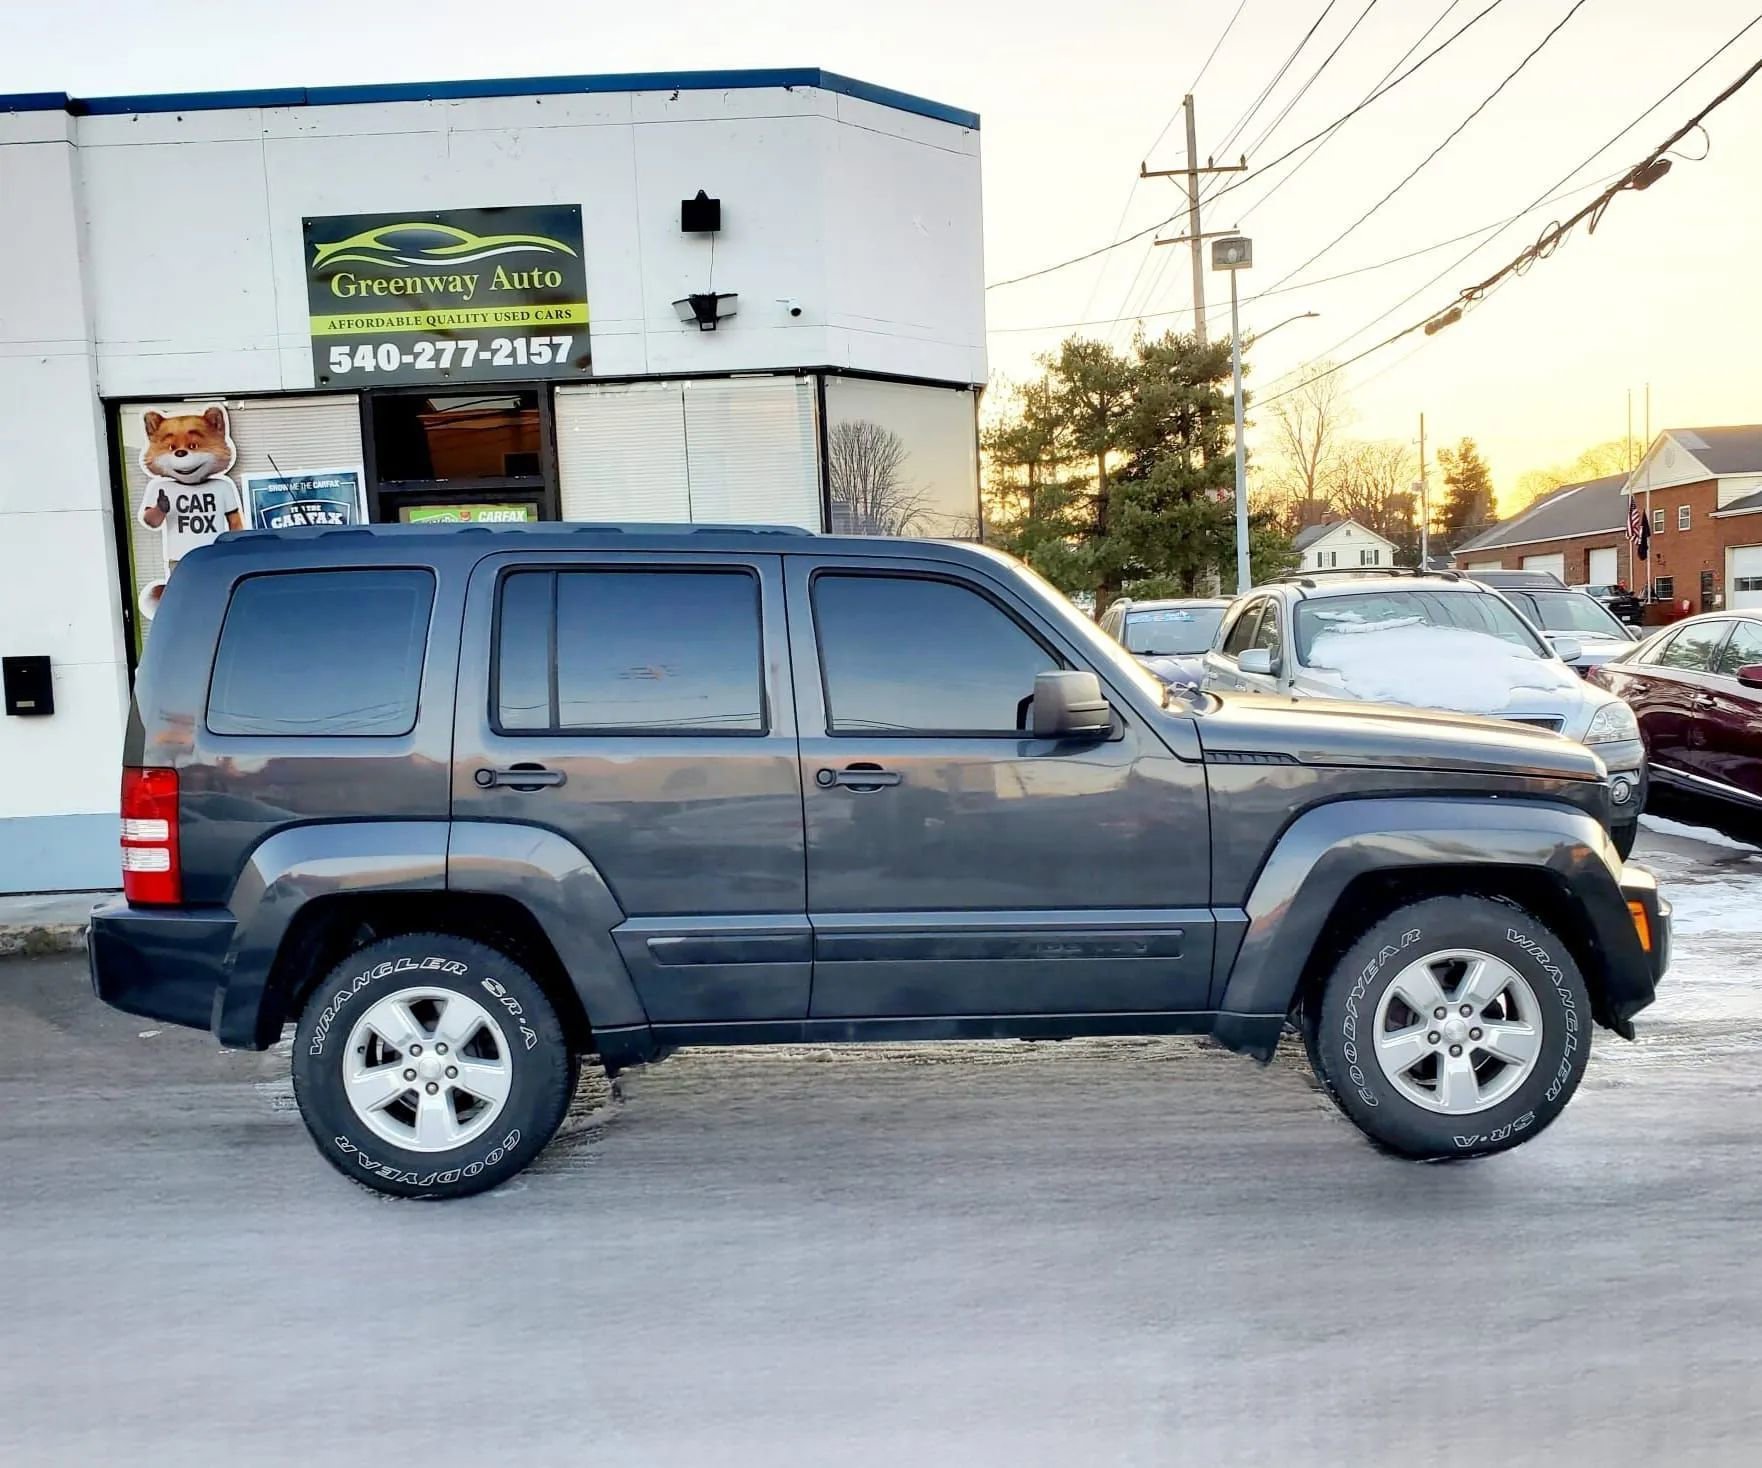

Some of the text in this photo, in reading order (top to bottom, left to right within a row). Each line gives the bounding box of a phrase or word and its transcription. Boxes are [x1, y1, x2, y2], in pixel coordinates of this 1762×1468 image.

[330, 264, 563, 301] Greenway Auto
[327, 308, 573, 331] AFFORDABLE QUALITY USED CARS
[328, 335, 574, 375] 540-277-2157
[300, 481, 313, 490] THE
[312, 480, 340, 488] CARFAX
[175, 493, 217, 515] CAR
[478, 511, 526, 522] CARFAX
[177, 514, 217, 535] FOX
[271, 511, 343, 529] CARFAX
[310, 957, 469, 1055] WRANGLER
[1343, 928, 1421, 1107] GOODYEAR
[1507, 928, 1578, 1101] WRANGLER
[334, 1129, 521, 1186] GOODYEAR
